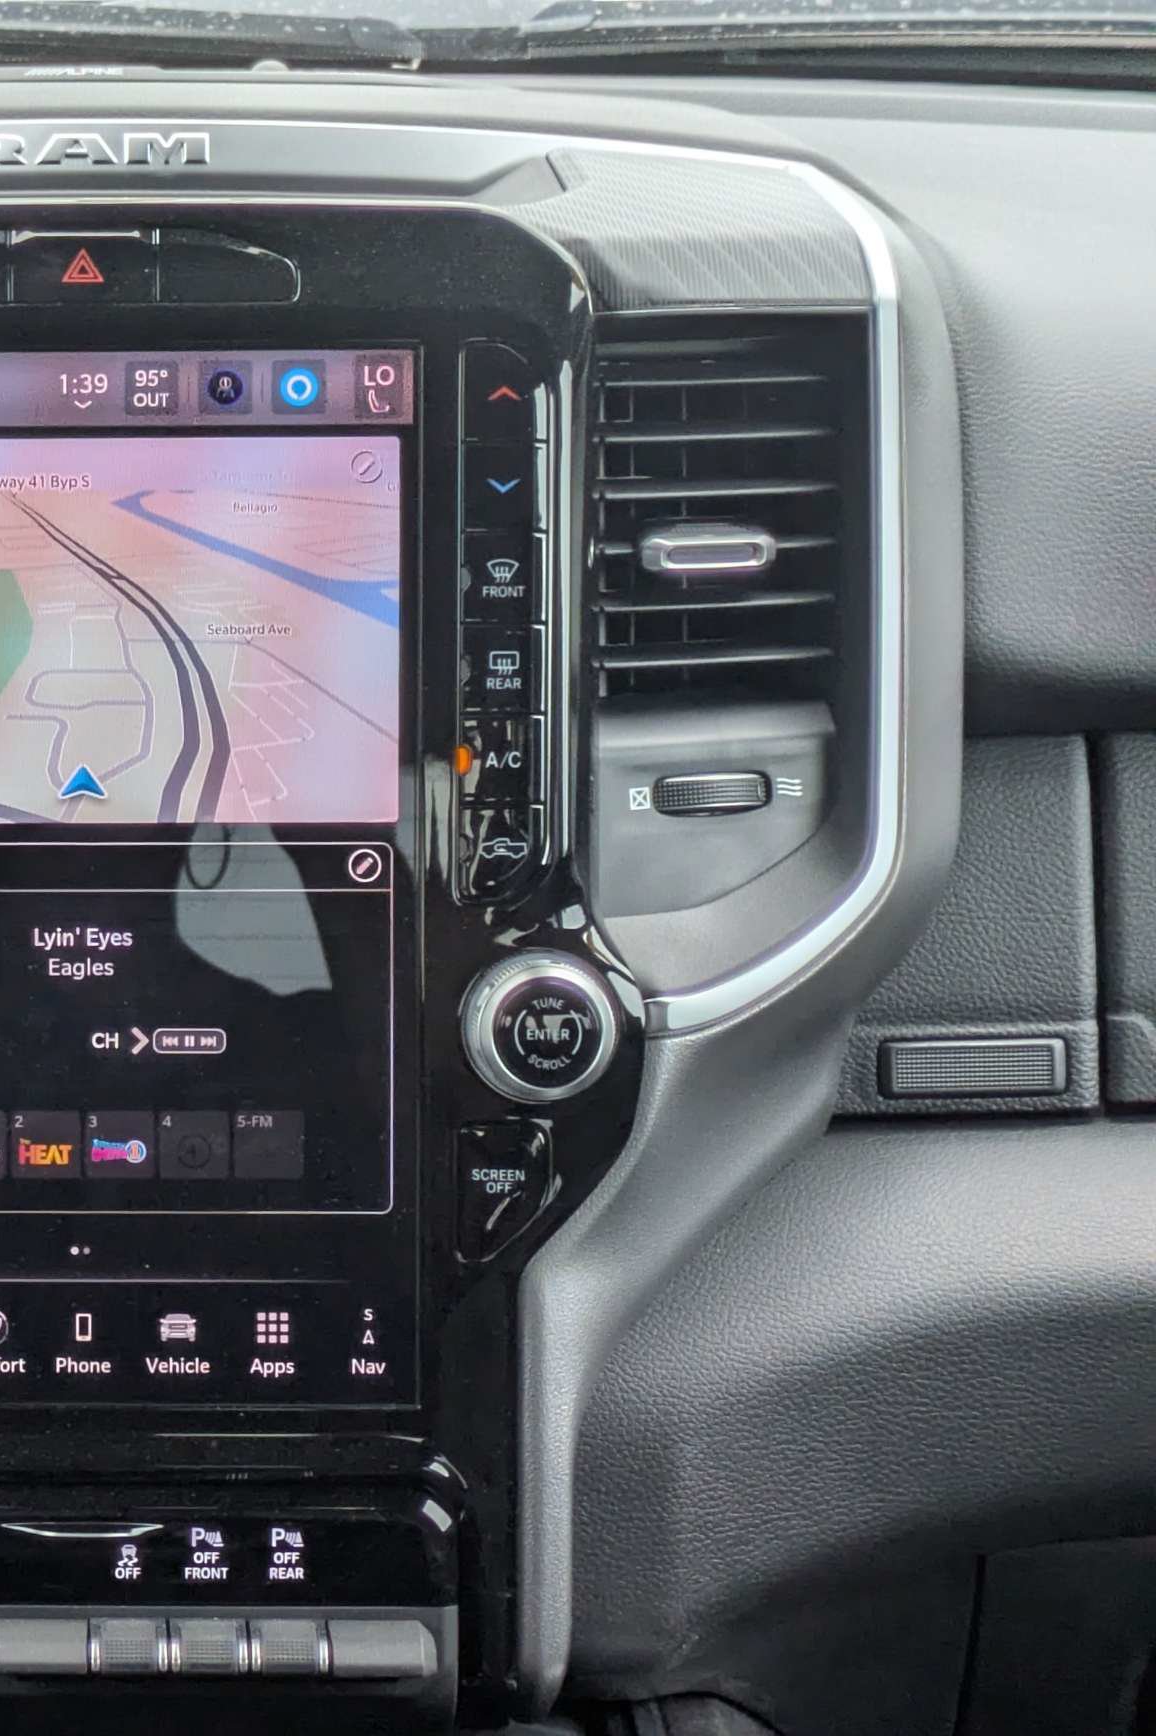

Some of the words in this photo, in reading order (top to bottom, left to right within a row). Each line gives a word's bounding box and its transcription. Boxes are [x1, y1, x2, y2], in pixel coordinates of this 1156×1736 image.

[364, 366, 394, 386] LO
[59, 373, 108, 395] 1:39
[133, 392, 170, 408] OUT
[50, 475, 79, 492] Byp
[82, 475, 90, 488] S
[482, 586, 526, 598] FRONT
[207, 624, 265, 635] Seaboard
[267, 624, 291, 635] Ave
[486, 678, 523, 690] REAR
[485, 751, 522, 769] A/C
[33, 927, 80, 950] Lyin'
[86, 927, 133, 950] Eyes
[48, 958, 115, 980] Eagles
[532, 997, 564, 1011] TUNE
[91, 1033, 119, 1049] CH
[526, 1028, 570, 1041] ENTER
[527, 1053, 572, 1070] SCROLL
[14, 1115, 23, 1128] 2
[88, 1115, 97, 1128] 3
[162, 1115, 172, 1127] 4
[19, 1144, 73, 1165] HEAT
[471, 1169, 525, 1181] SCREEN
[486, 1182, 513, 1193] OFF
[55, 1357, 111, 1374] Phone
[146, 1357, 210, 1374] Vehicle
[250, 1357, 295, 1378] Apps
[351, 1358, 386, 1375] Nav
[193, 1552, 220, 1564] OFF
[273, 1552, 300, 1564] OFF
[115, 1567, 141, 1579] OFF
[184, 1567, 229, 1579] FRONT
[269, 1567, 304, 1579] REAR
